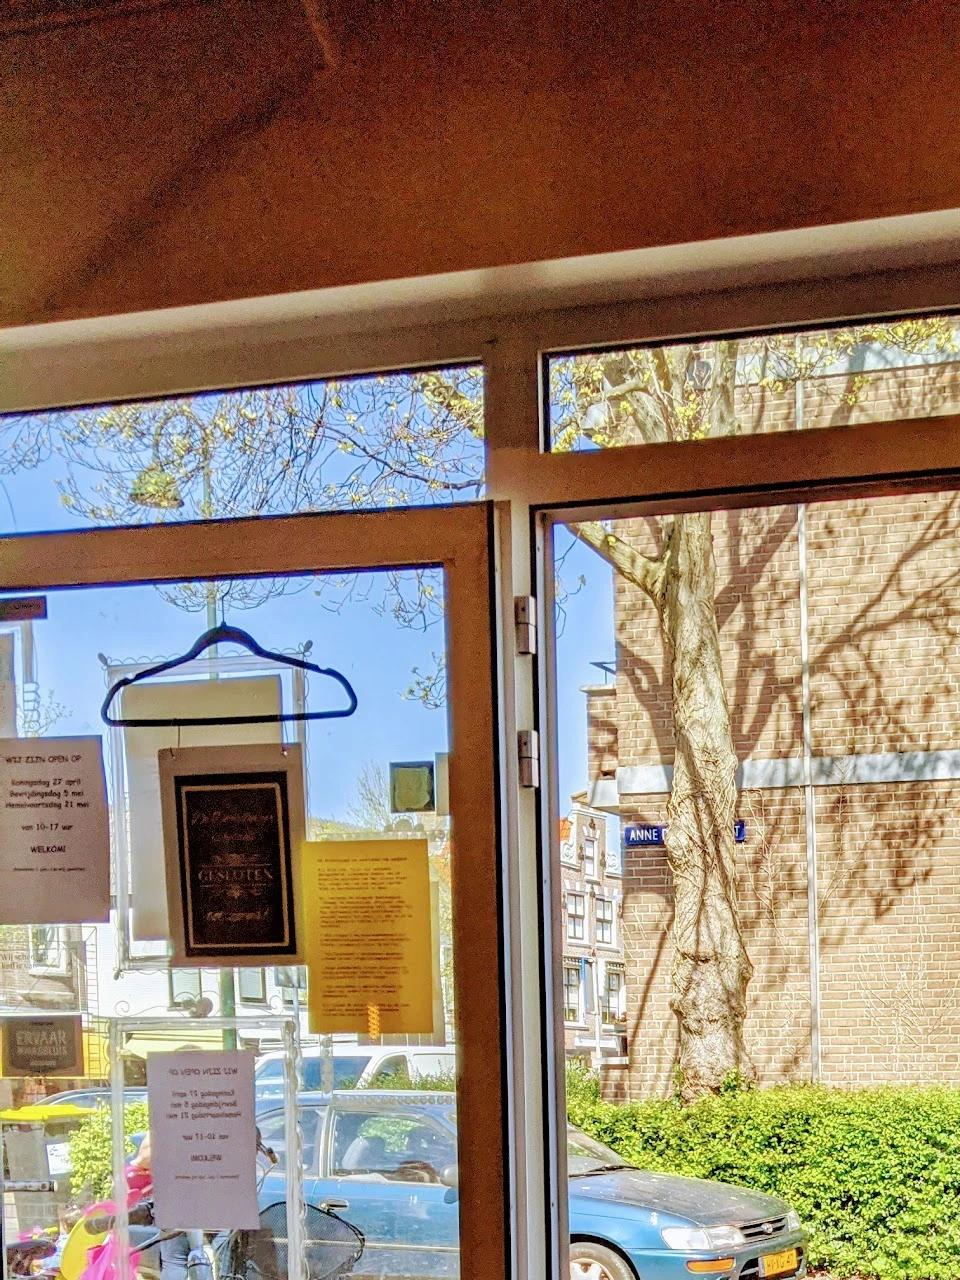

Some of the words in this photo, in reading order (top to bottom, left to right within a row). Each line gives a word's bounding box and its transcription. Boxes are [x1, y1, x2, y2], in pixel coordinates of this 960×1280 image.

[49, 755, 69, 764] OPEN
[71, 754, 82, 763] OP
[52, 778, 62, 786] 27
[71, 789, 84, 797] mei
[64, 800, 74, 808] 21
[36, 822, 59, 831] 10-17
[62, 823, 74, 831] uur
[629, 828, 659, 842] ANNE
[15, 1029, 67, 1045] ERVAAR
